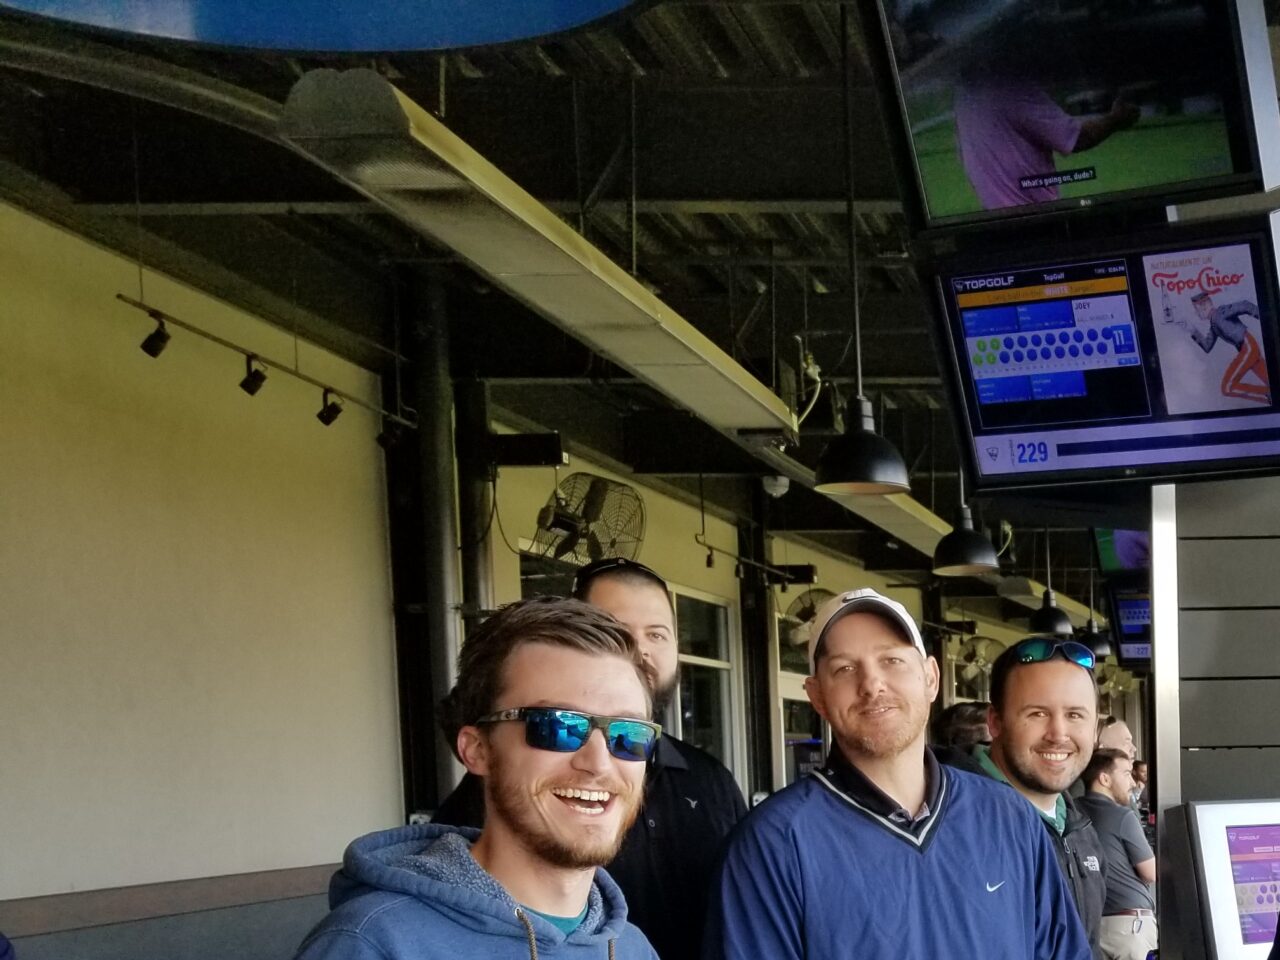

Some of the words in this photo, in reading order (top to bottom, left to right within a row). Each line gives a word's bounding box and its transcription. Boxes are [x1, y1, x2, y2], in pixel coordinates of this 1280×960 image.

[1021, 178, 1043, 188] What's
[1044, 176, 1062, 186] going
[1073, 170, 1094, 180] dude?
[964, 276, 1015, 290] TOPGOLF
[1151, 272, 1199, 295] Topo
[1198, 266, 1245, 295] Chico
[1074, 302, 1091, 311] JOEY
[1113, 330, 1125, 346] 11
[1016, 441, 1049, 464] 229
